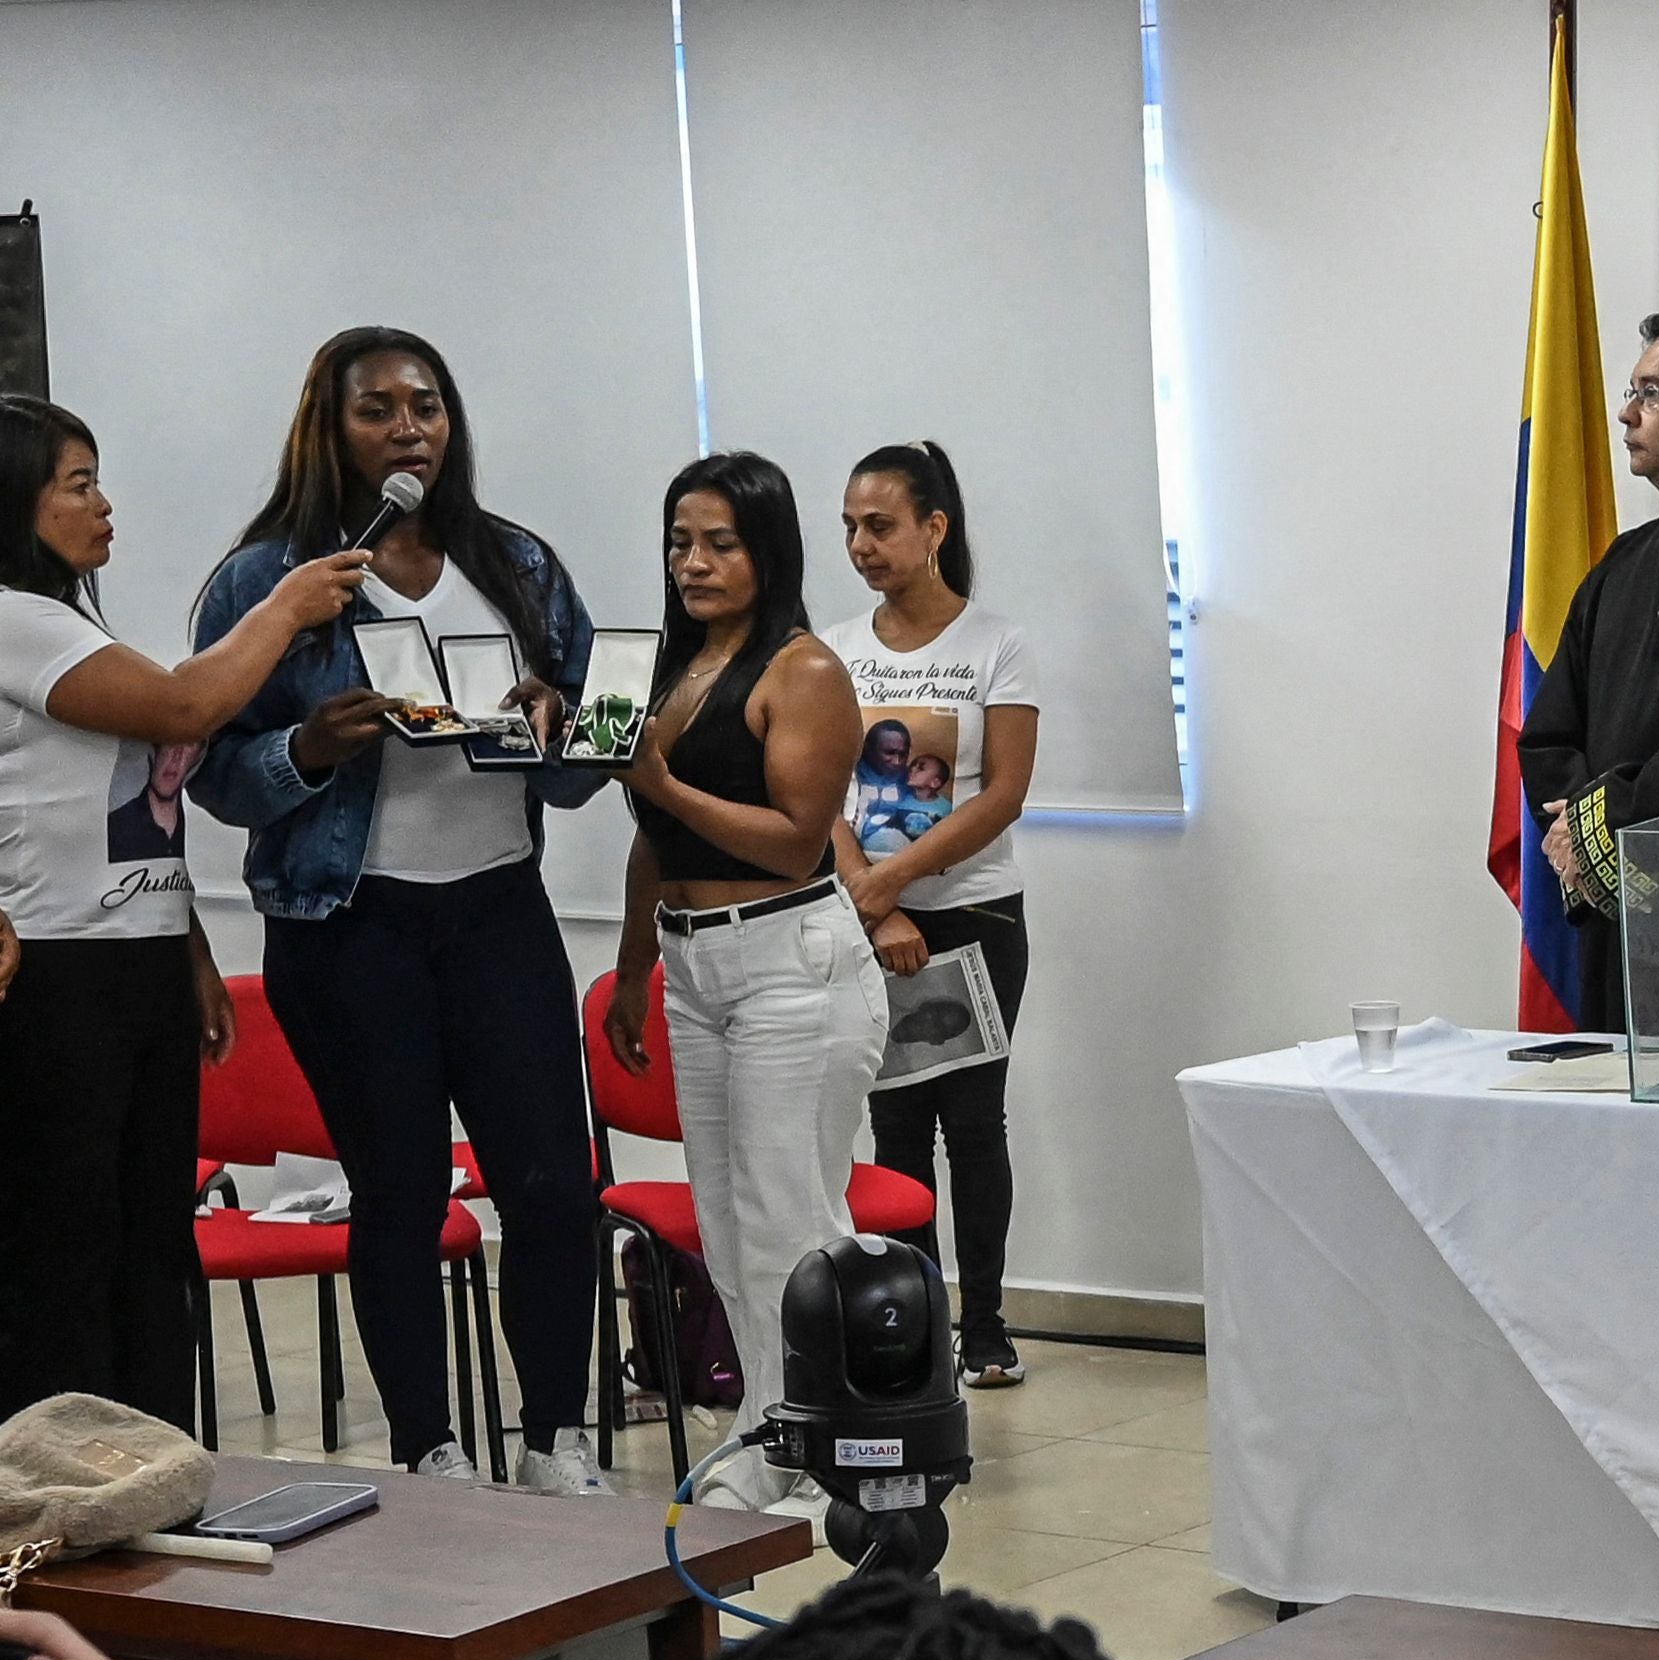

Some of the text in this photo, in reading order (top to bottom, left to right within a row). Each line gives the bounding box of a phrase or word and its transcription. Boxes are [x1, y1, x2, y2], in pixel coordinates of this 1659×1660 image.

[925, 663, 940, 678] la
[943, 663, 976, 679] vida
[916, 681, 977, 700] Presente
[884, 1307, 898, 1327] 2
[858, 1445, 900, 1456] USAID
